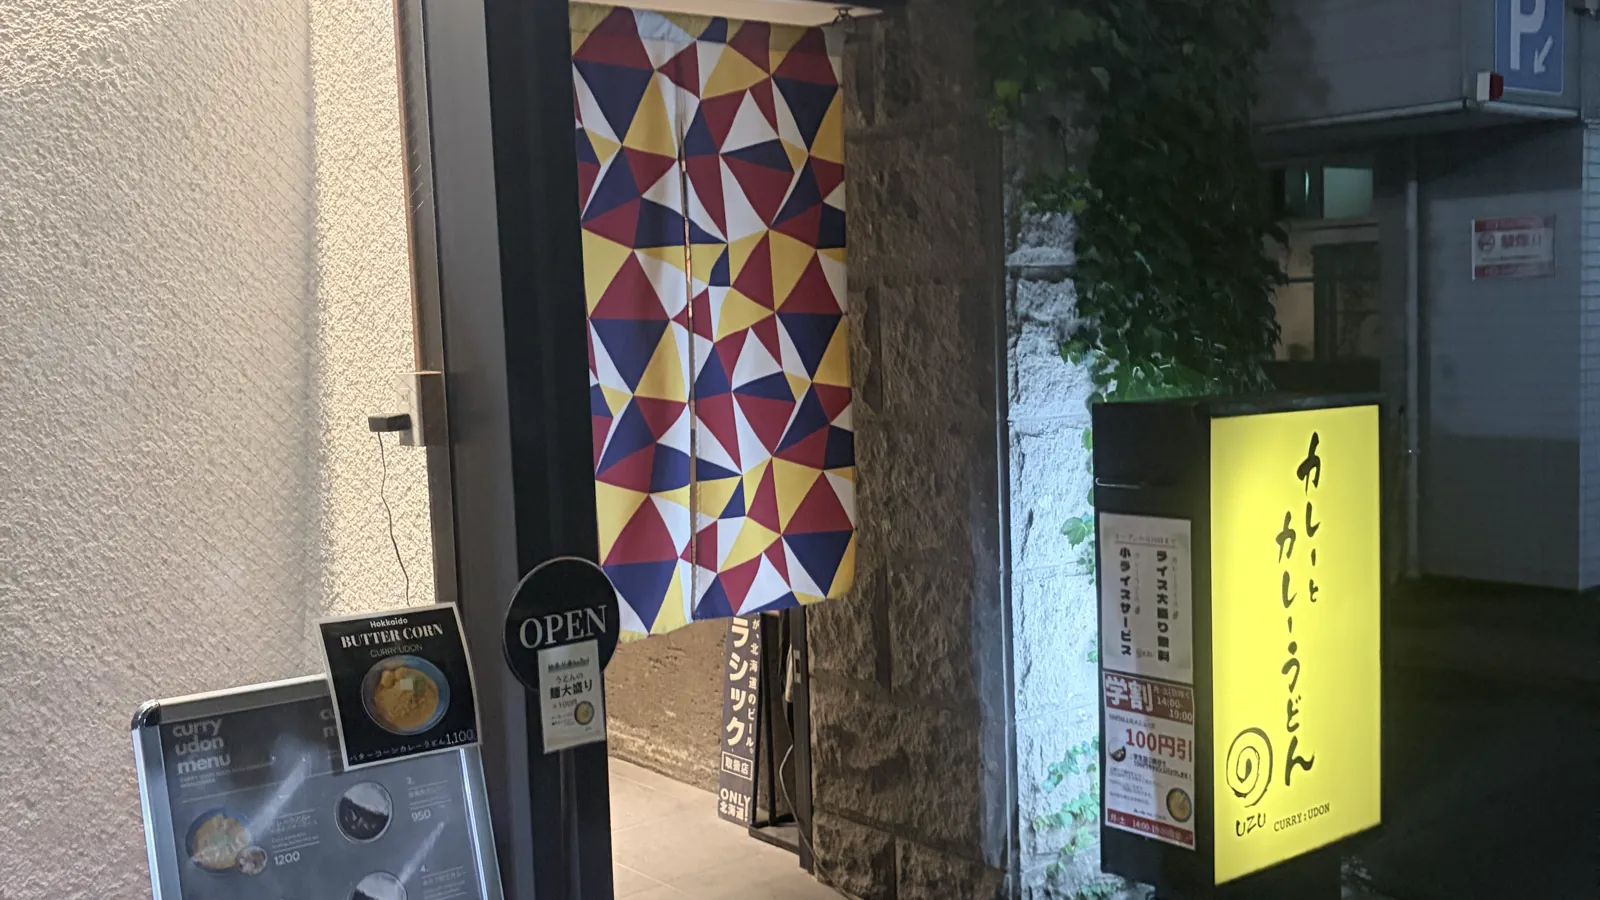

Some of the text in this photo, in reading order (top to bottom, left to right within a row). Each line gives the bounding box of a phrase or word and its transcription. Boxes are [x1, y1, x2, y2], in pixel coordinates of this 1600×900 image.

[1510, 0, 1546, 71] P
[369, 617, 408, 629] Hokkaido
[519, 604, 608, 649] OPEN
[340, 623, 444, 649] BUTTER CORN
[369, 643, 423, 658] CURRY UDON
[555, 672, 584, 685] うどんの
[746, 611, 761, 754] が、北海道のビール。
[1105, 675, 1154, 713] 学割
[1169, 708, 1193, 721] 19:00
[172, 718, 223, 738] curry
[445, 728, 475, 746] 1,100
[175, 735, 224, 756] udon
[1125, 727, 1193, 763] 100円引
[177, 754, 231, 775] menu
[720, 787, 751, 808] ONLY
[411, 809, 432, 822] 950
[1235, 813, 1266, 837] UZU
[273, 851, 300, 866] 1200
